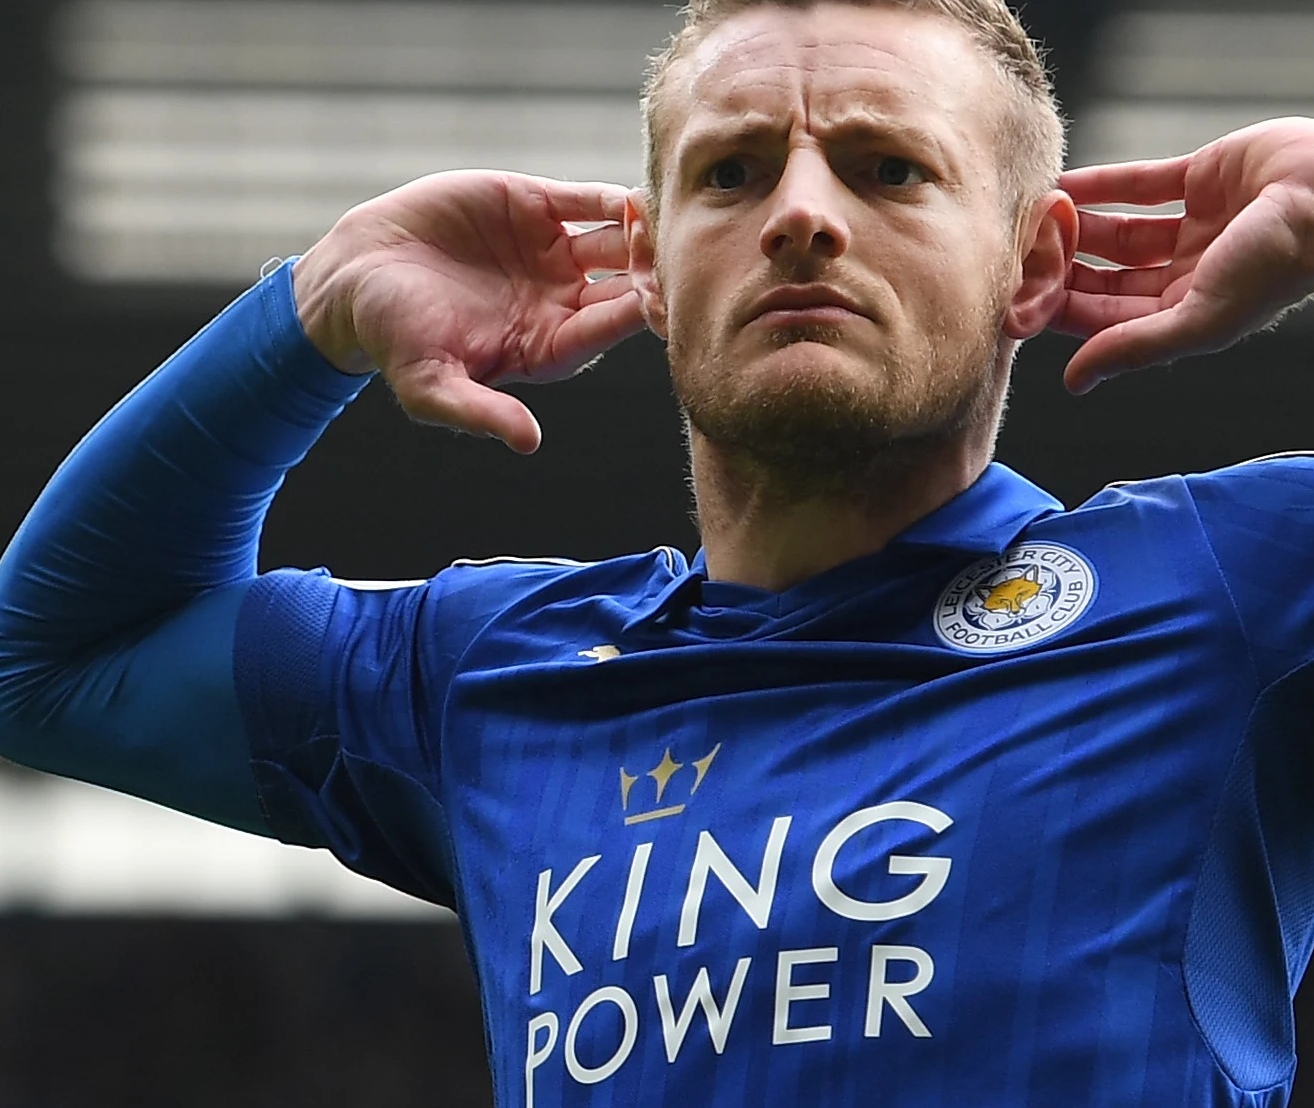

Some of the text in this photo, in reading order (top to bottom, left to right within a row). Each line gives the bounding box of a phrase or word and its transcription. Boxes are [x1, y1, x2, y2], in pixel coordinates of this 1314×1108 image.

[1040, 551, 1080, 573] CITY
[946, 580, 1083, 646] FOOTBALL CLUB
[529, 800, 954, 996] KING
